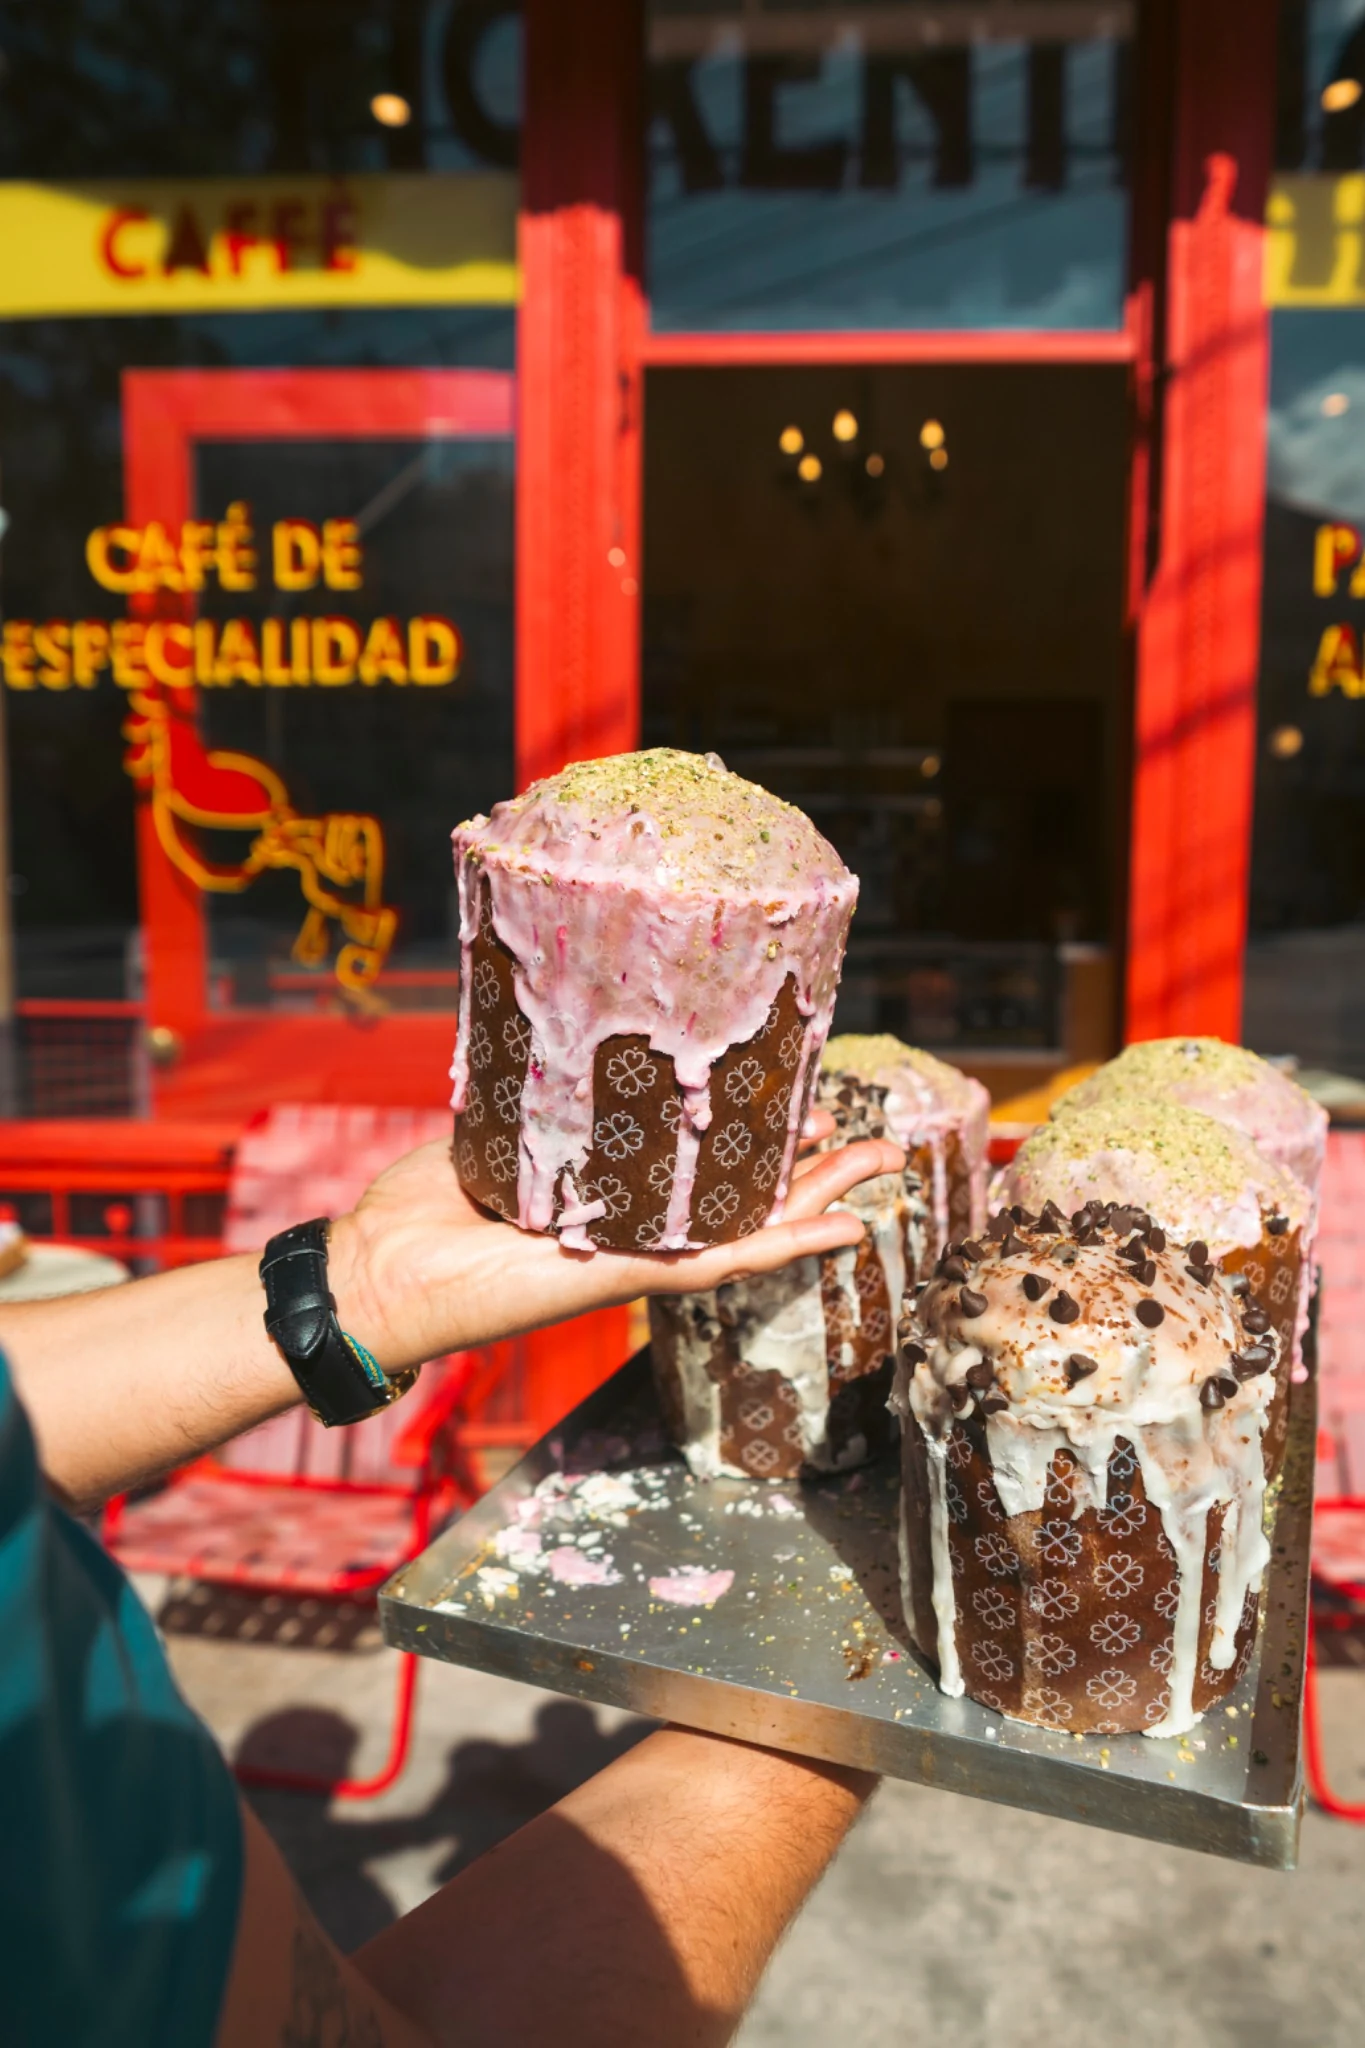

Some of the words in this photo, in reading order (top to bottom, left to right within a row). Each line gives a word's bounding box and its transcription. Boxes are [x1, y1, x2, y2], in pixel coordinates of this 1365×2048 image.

[86, 501, 257, 592] CAFÉ
[272, 517, 364, 591] DE
[1, 614, 463, 690] ESPECIALIDAD
